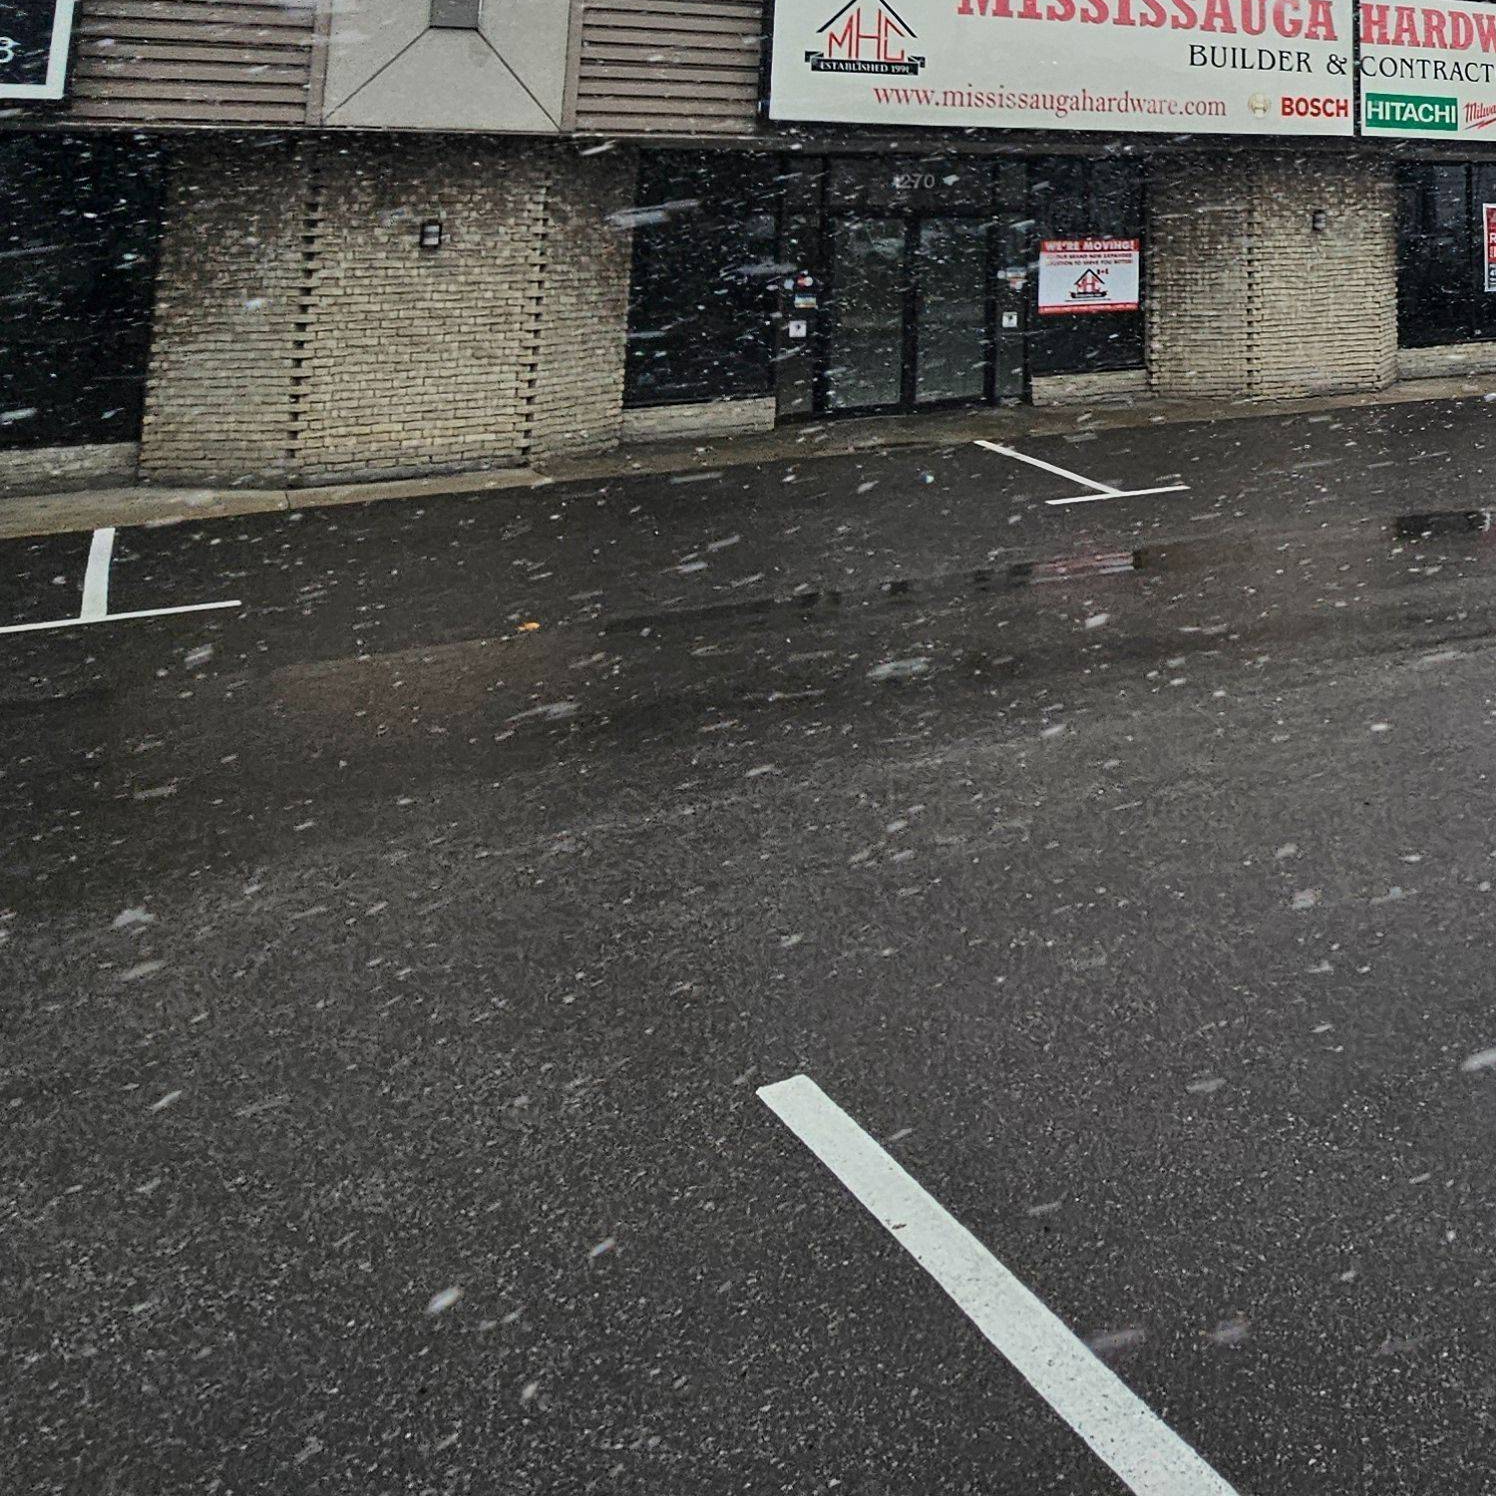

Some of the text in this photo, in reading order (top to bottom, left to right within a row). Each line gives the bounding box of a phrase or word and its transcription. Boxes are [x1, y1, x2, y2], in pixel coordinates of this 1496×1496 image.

[828, 8, 906, 63] MHC
[820, 60, 889, 73] ESTABLISHED
[1188, 44, 1312, 73] BUILDER
[1326, 53, 1347, 76] &
[873, 84, 1227, 118] www.mississaugahardware.com
[1281, 96, 1349, 118] BOSCH
[1366, 101, 1457, 124] HITACHI
[1083, 240, 1134, 250] MOVING!
